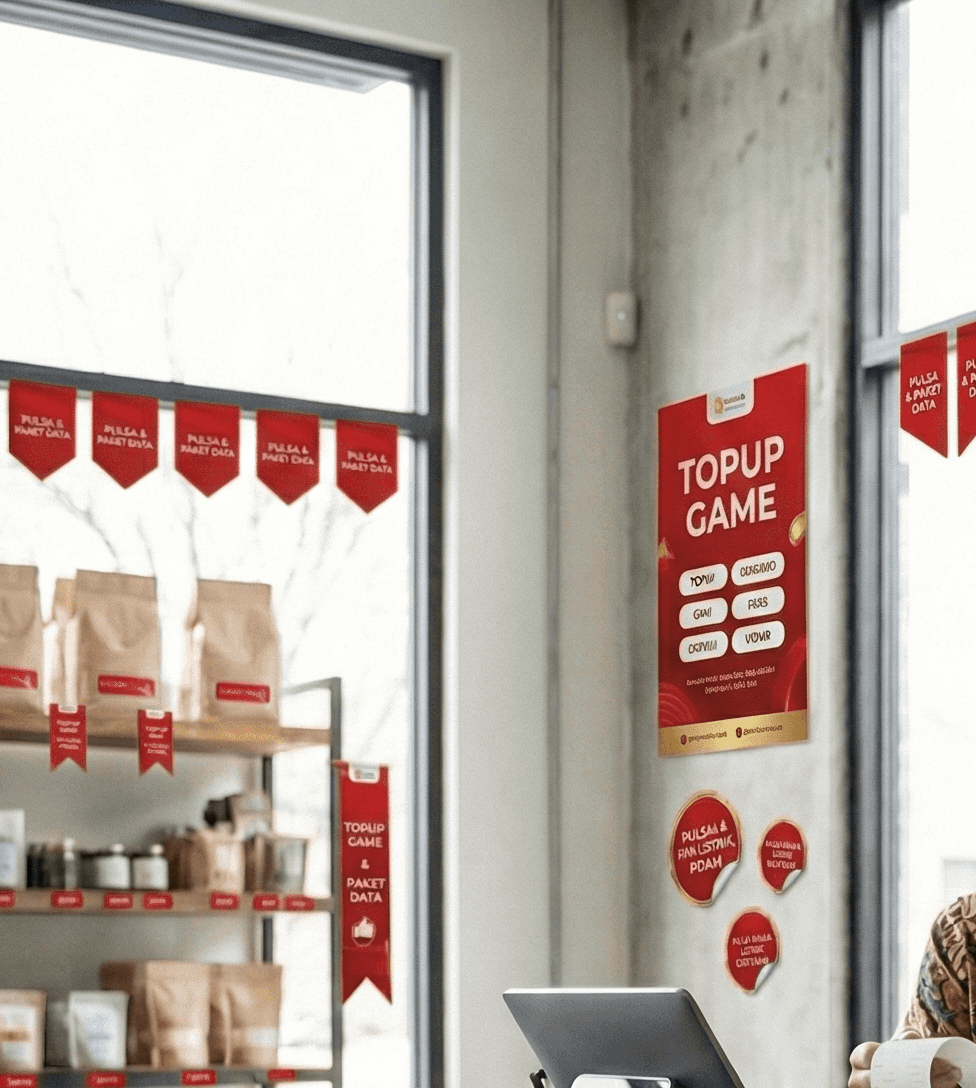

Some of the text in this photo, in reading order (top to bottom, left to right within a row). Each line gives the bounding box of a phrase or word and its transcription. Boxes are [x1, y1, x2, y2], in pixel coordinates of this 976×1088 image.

[678, 436, 784, 494] TOPUP
[686, 483, 777, 537] GAME
[347, 877, 386, 890] PAKET
[350, 891, 382, 903] DATA
